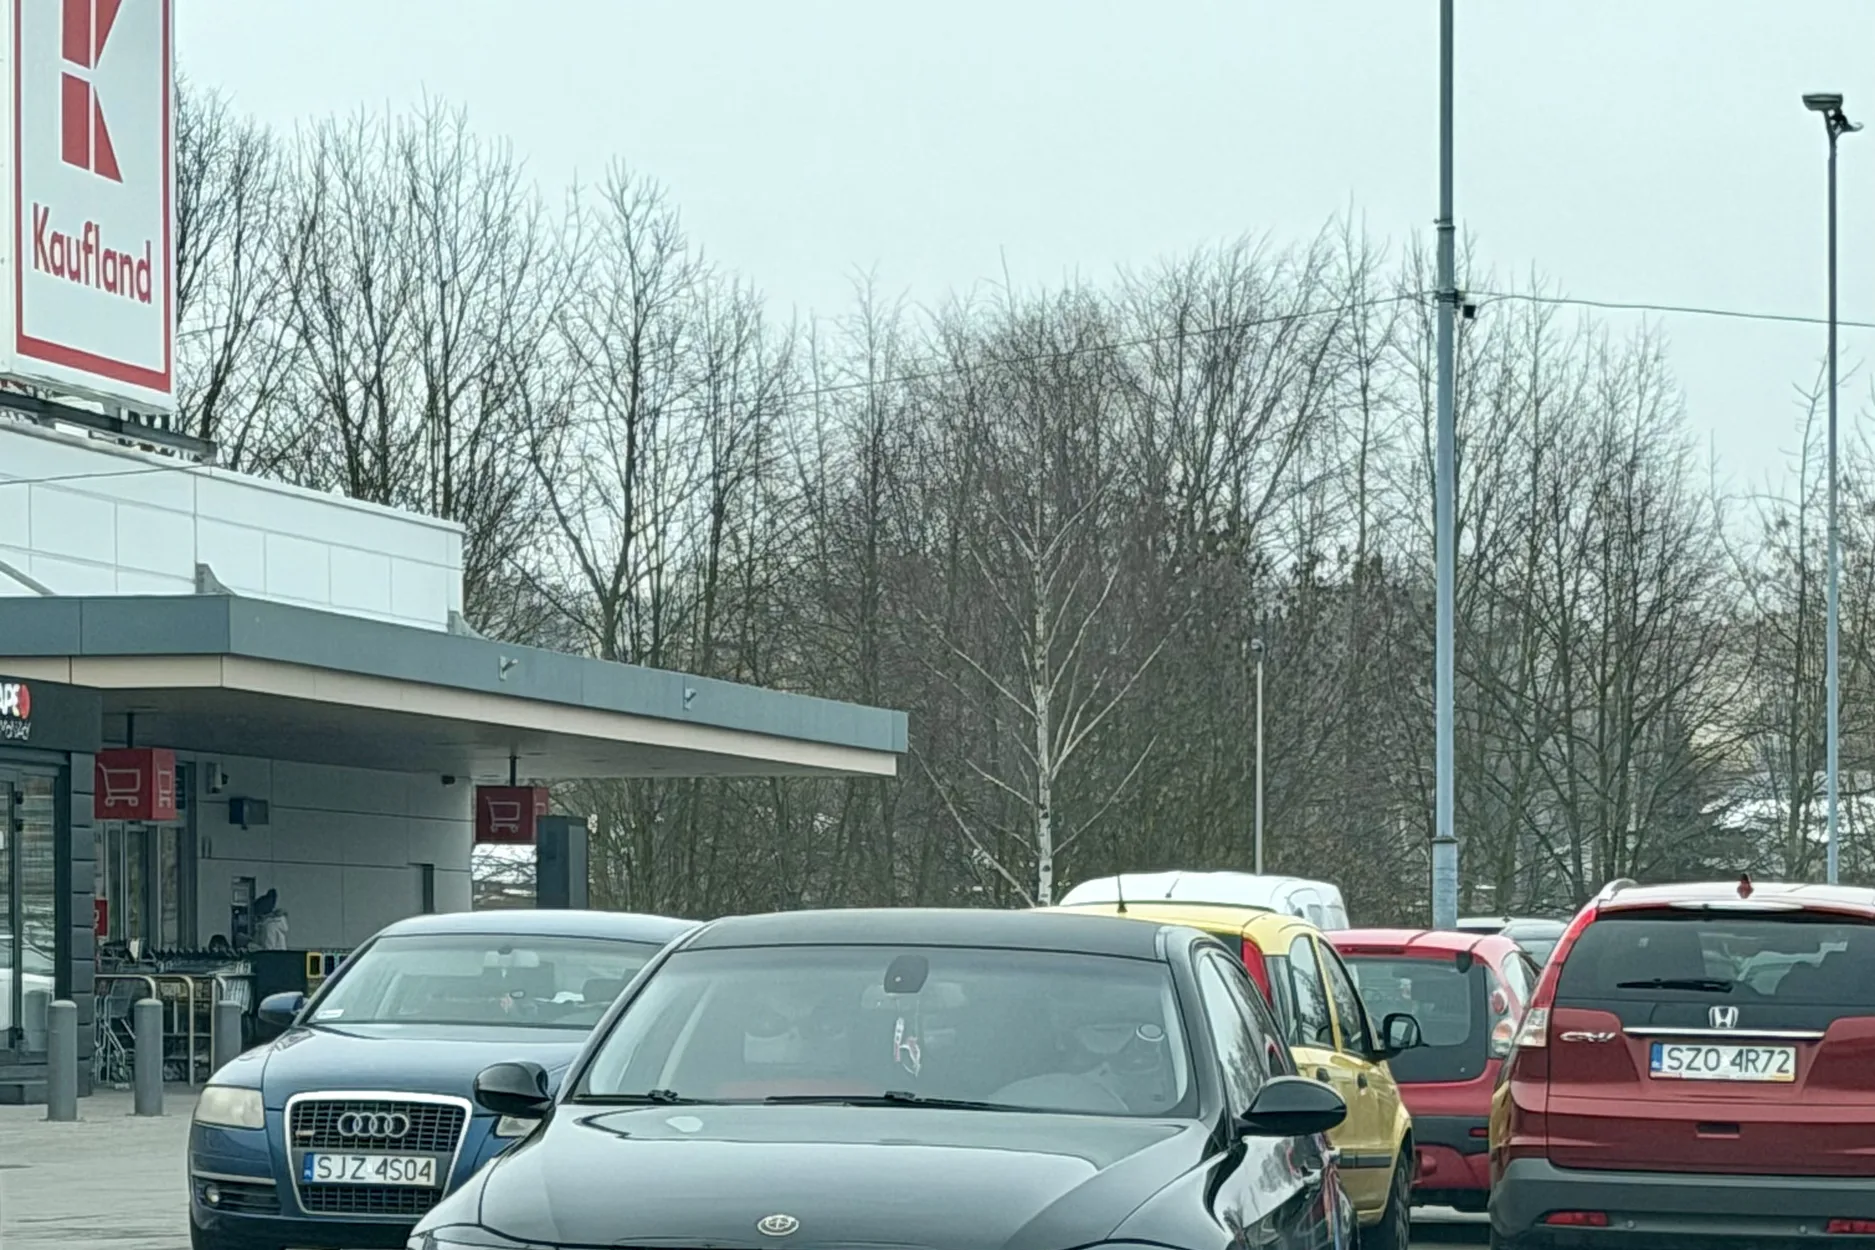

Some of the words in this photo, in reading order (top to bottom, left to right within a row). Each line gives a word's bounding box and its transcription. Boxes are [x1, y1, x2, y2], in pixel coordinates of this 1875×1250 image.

[33, 202, 152, 304] Kaufland
[1667, 1047, 1720, 1072] SZO
[1730, 1048, 1790, 1074] 4R72
[317, 1156, 366, 1180] SJZ
[374, 1157, 431, 1182] 4S04
